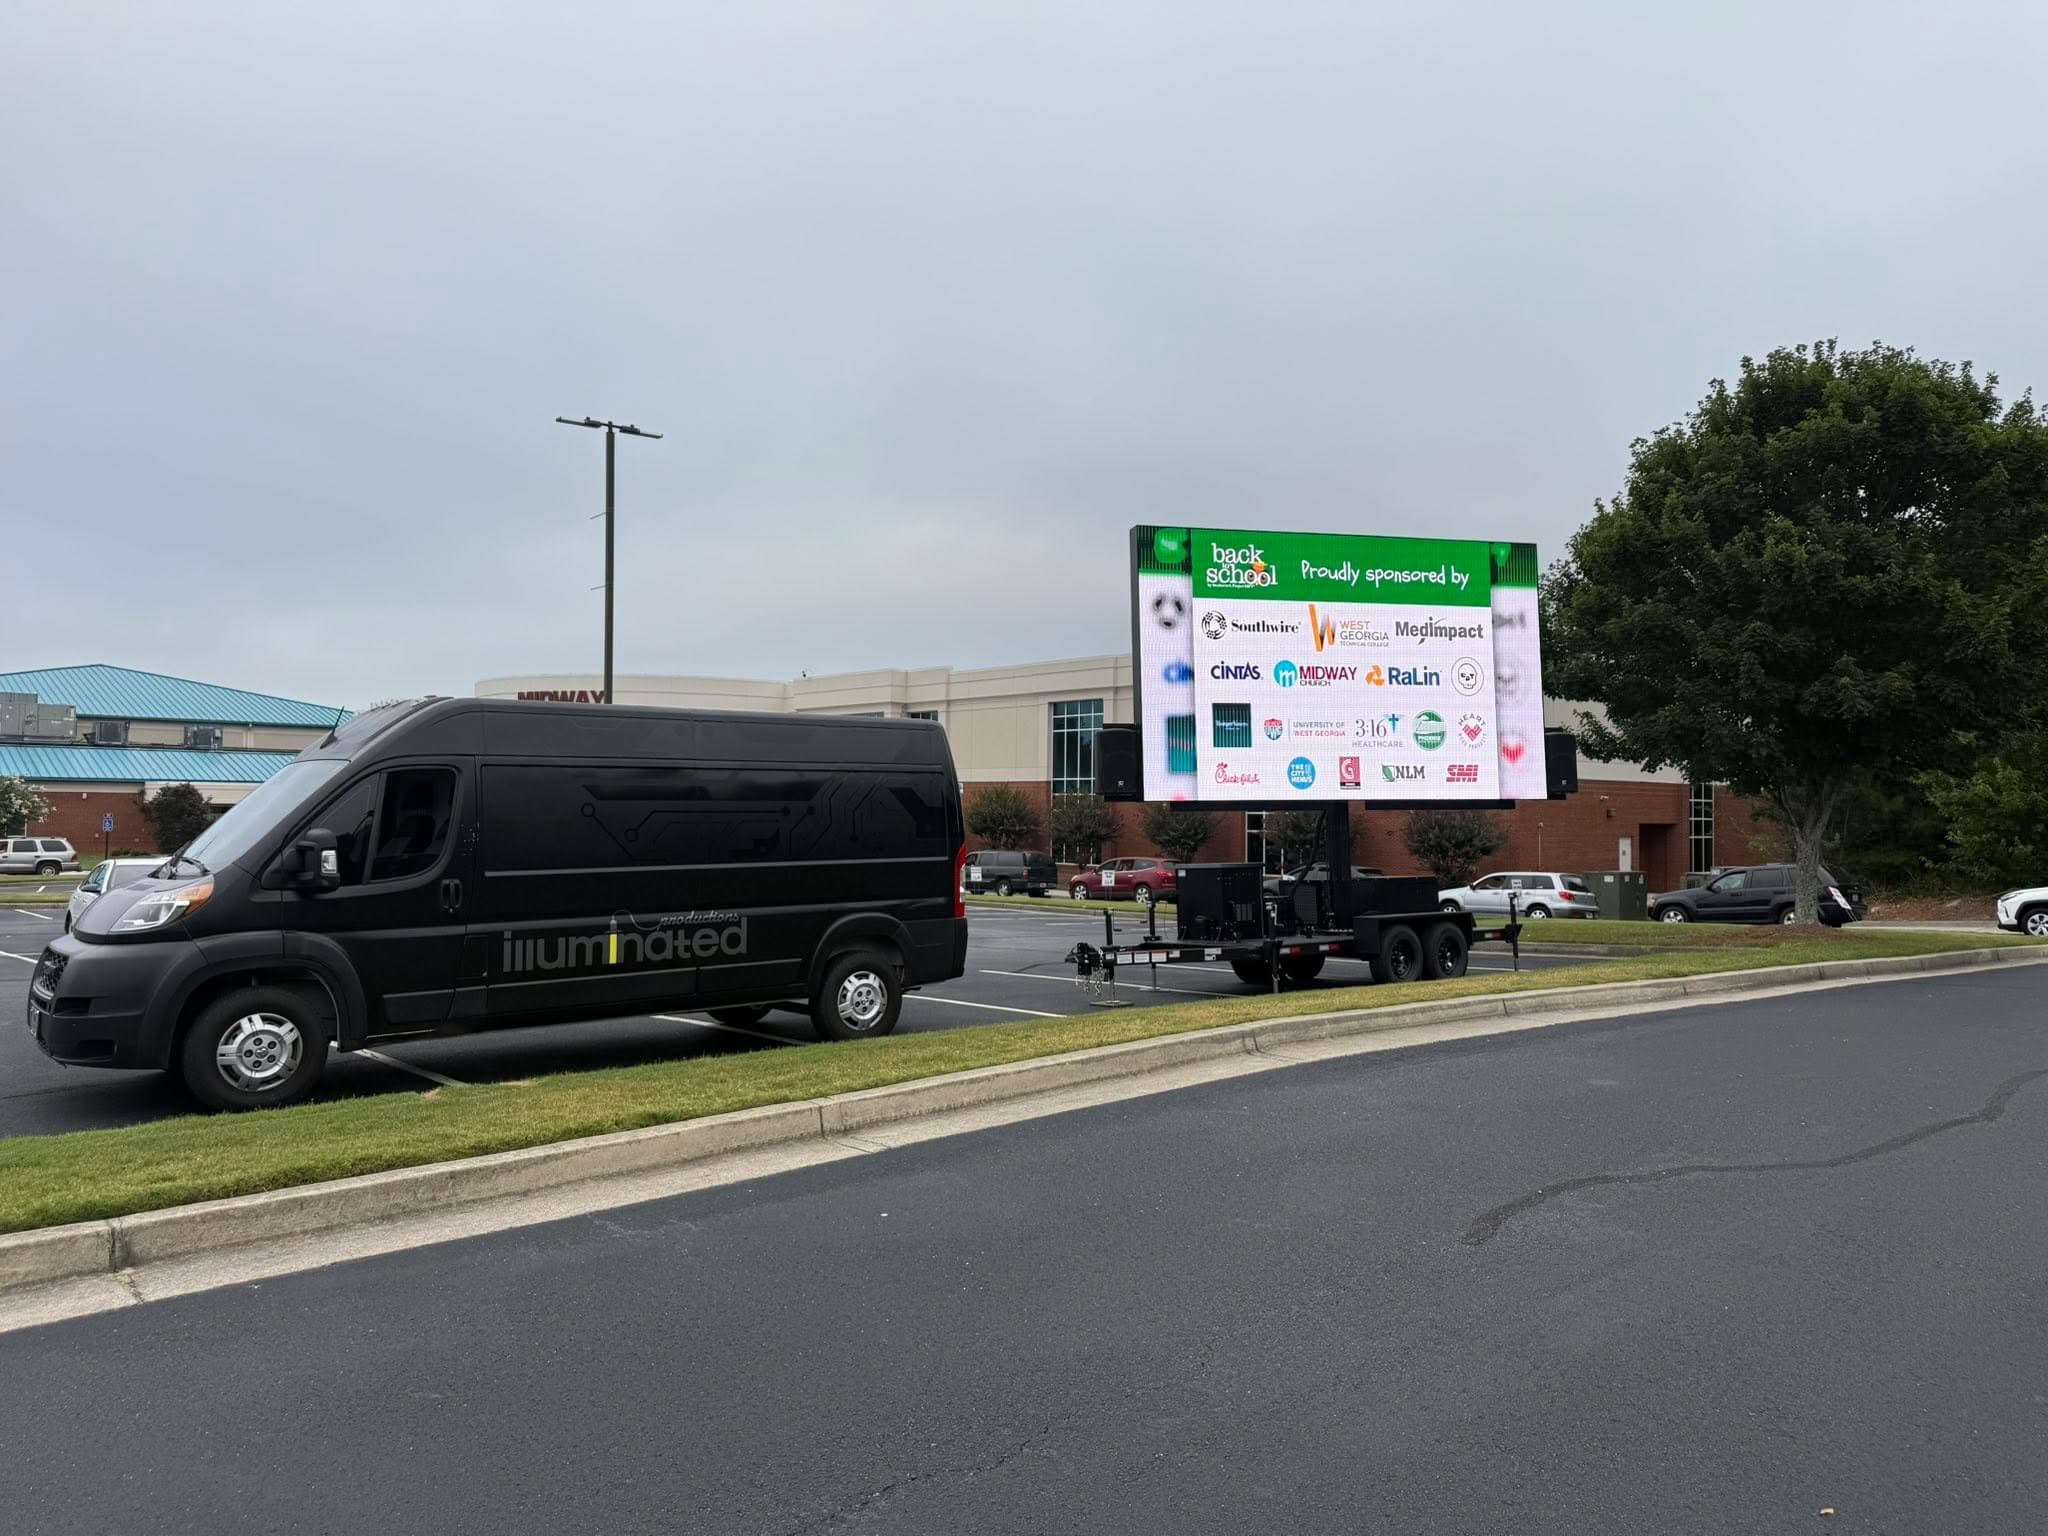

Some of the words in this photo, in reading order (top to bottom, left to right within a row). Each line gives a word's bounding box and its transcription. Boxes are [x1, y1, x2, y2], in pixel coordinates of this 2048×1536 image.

[1211, 541, 1268, 565] back
[1206, 563, 1279, 587] school
[1301, 559, 1360, 587] Proudly
[1365, 564, 1446, 588] sponsored
[1451, 565, 1470, 591] by
[1231, 619, 1299, 634] Southwire
[1339, 620, 1371, 630] WEST
[1339, 630, 1390, 641] GEORGIA
[1299, 665, 1358, 682] MIDWAY
[1388, 666, 1441, 686] RaLin
[1355, 718, 1387, 738] 3:16
[1458, 712, 1487, 727] HEART
[1352, 740, 1405, 748] HEALTHCARE
[1395, 765, 1426, 780] NLM
[656, 909, 741, 929] productions
[502, 916, 748, 973] illuminated
